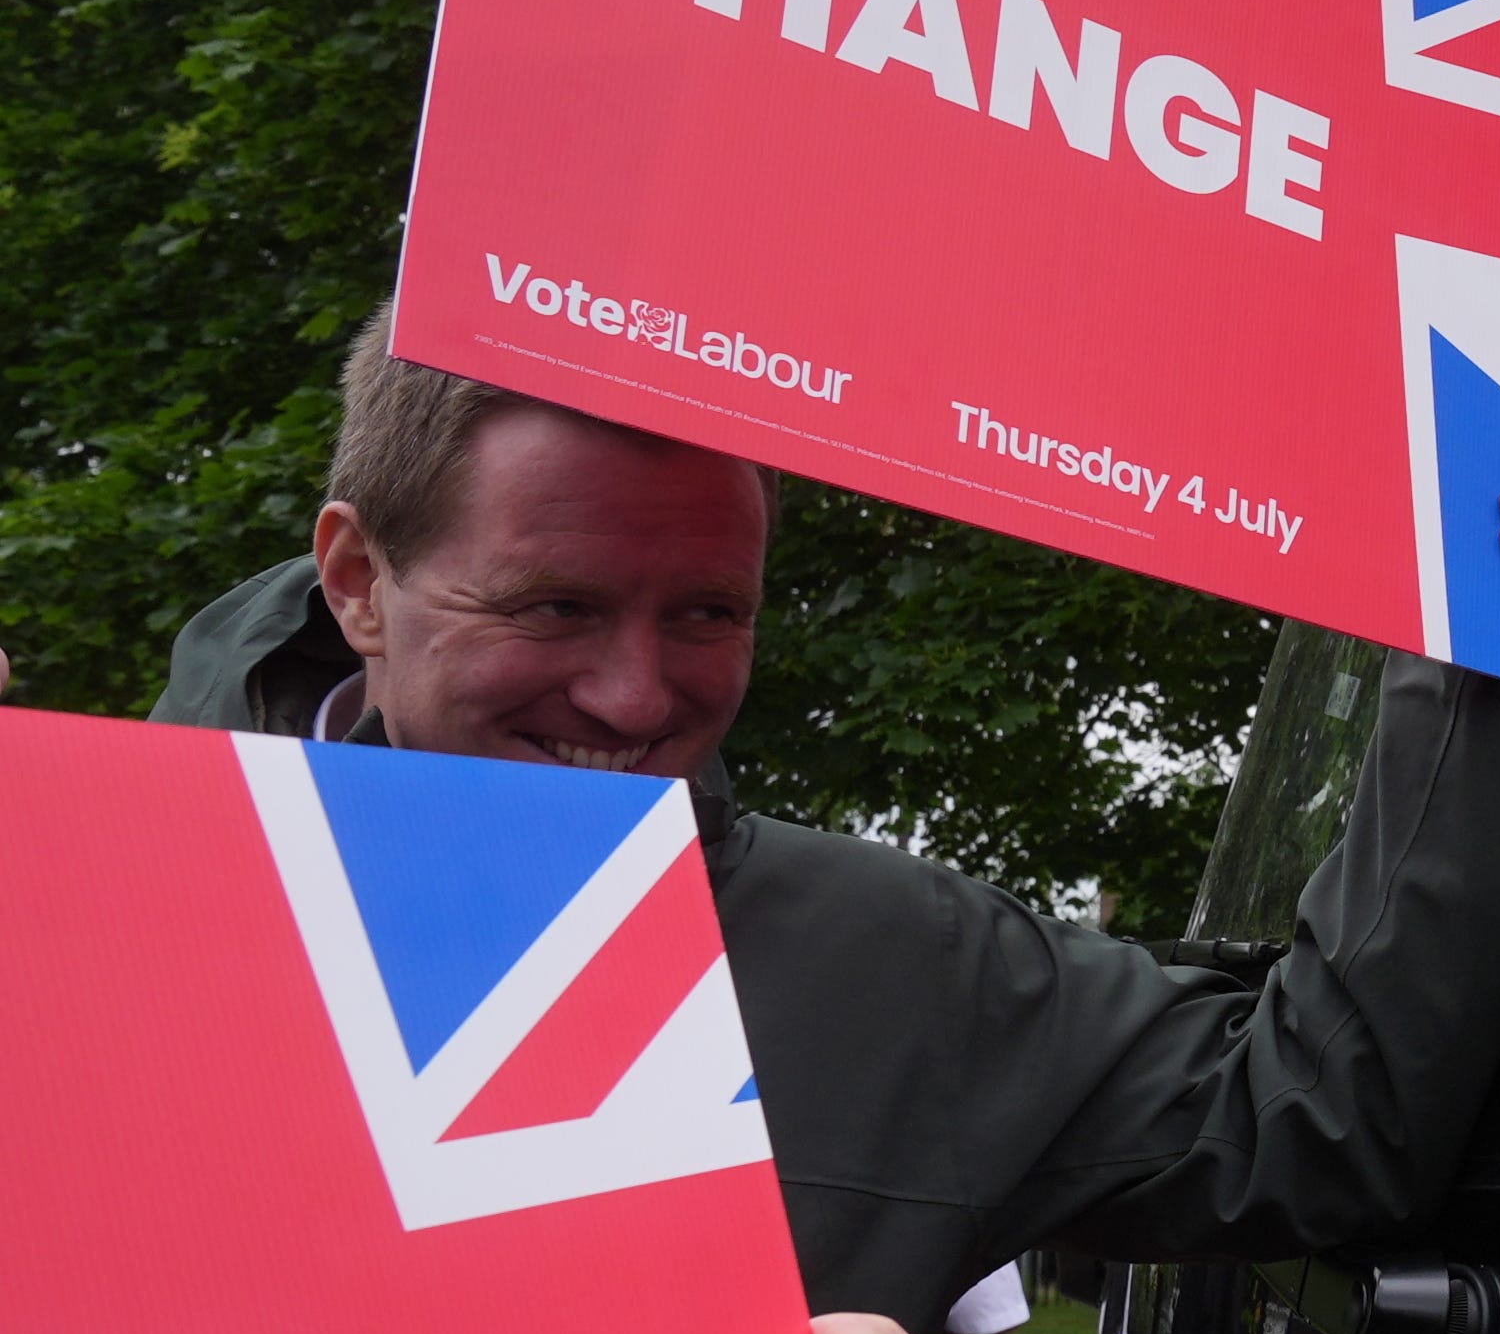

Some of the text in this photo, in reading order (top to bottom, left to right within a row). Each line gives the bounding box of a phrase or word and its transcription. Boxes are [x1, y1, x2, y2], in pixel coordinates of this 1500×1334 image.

[486, 253, 852, 403] Vote Labour
[952, 401, 1303, 554] Thursday 4 July
